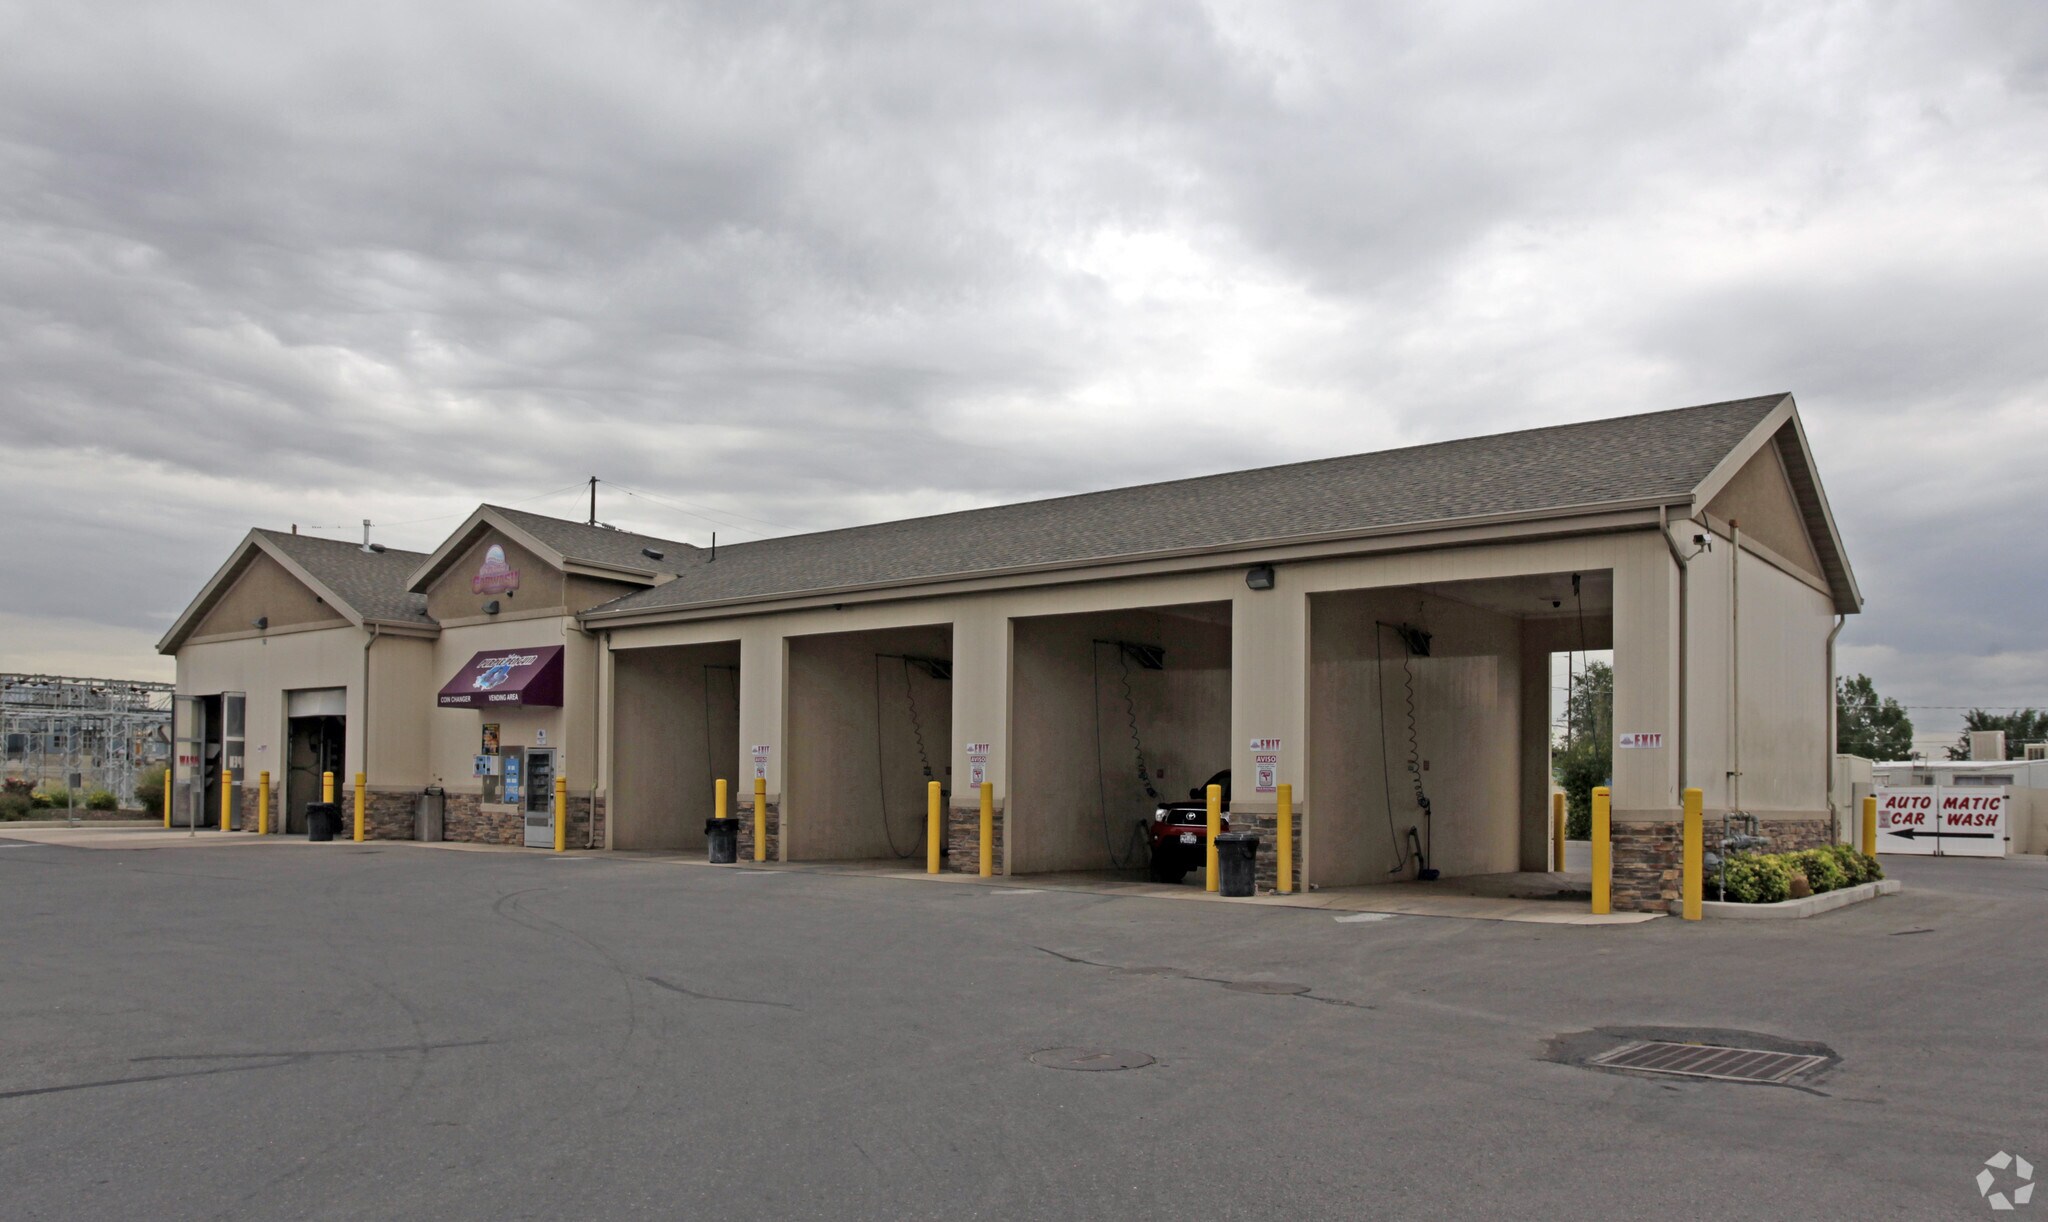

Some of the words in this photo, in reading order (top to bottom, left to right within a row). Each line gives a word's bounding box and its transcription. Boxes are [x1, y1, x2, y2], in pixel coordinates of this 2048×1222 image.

[451, 695, 471, 703] CHANGER
[488, 694, 506, 702] VENDING
[506, 693, 519, 701] AREA
[1260, 739, 1280, 750] EXIT
[1634, 734, 1662, 748] EXIT
[757, 745, 770, 753] EXIT
[974, 743, 989, 753] EXIT
[1256, 755, 1276, 763] AVISO
[1885, 796, 1932, 809] AUTO
[1942, 796, 2001, 810] MATIC
[1891, 812, 1926, 825] CAR
[1946, 813, 1999, 826] WASH
